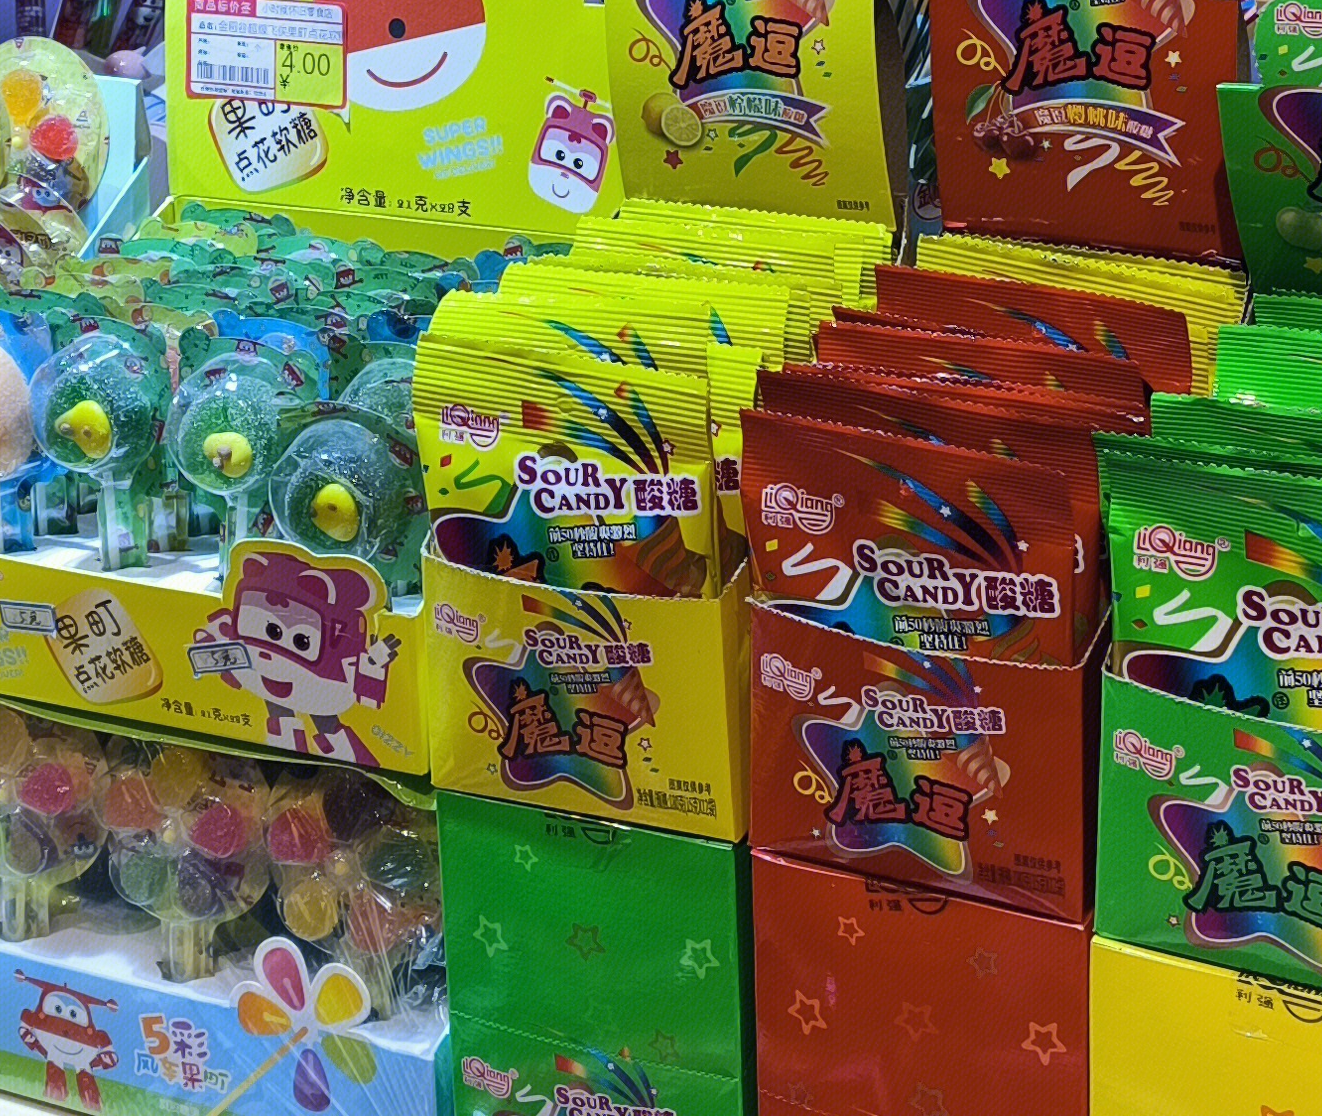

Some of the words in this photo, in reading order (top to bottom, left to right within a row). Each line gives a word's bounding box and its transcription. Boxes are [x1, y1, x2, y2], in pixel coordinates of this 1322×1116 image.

[282, 50, 331, 77] 4.00
[1005, 9, 1151, 91] 魔逗
[423, 116, 488, 146] SUPER
[517, 456, 601, 487] SOUR
[534, 478, 627, 513] CANDY
[634, 478, 698, 512] 酸糖
[856, 543, 950, 582] SOUR
[877, 573, 977, 605] CANDY
[984, 575, 1055, 613] 酸糖
[524, 629, 583, 650] SOUR
[537, 644, 601, 666] CANDY
[606, 642, 651, 665] 酸糖
[74, 635, 152, 694] 点花软糖
[863, 689, 927, 714] SOUR
[501, 693, 625, 766] 魔逗
[878, 707, 947, 731] CANDY
[952, 709, 1003, 732] 酸糖
[829, 758, 970, 838] 魔逗
[1233, 768, 1305, 798] SOUR
